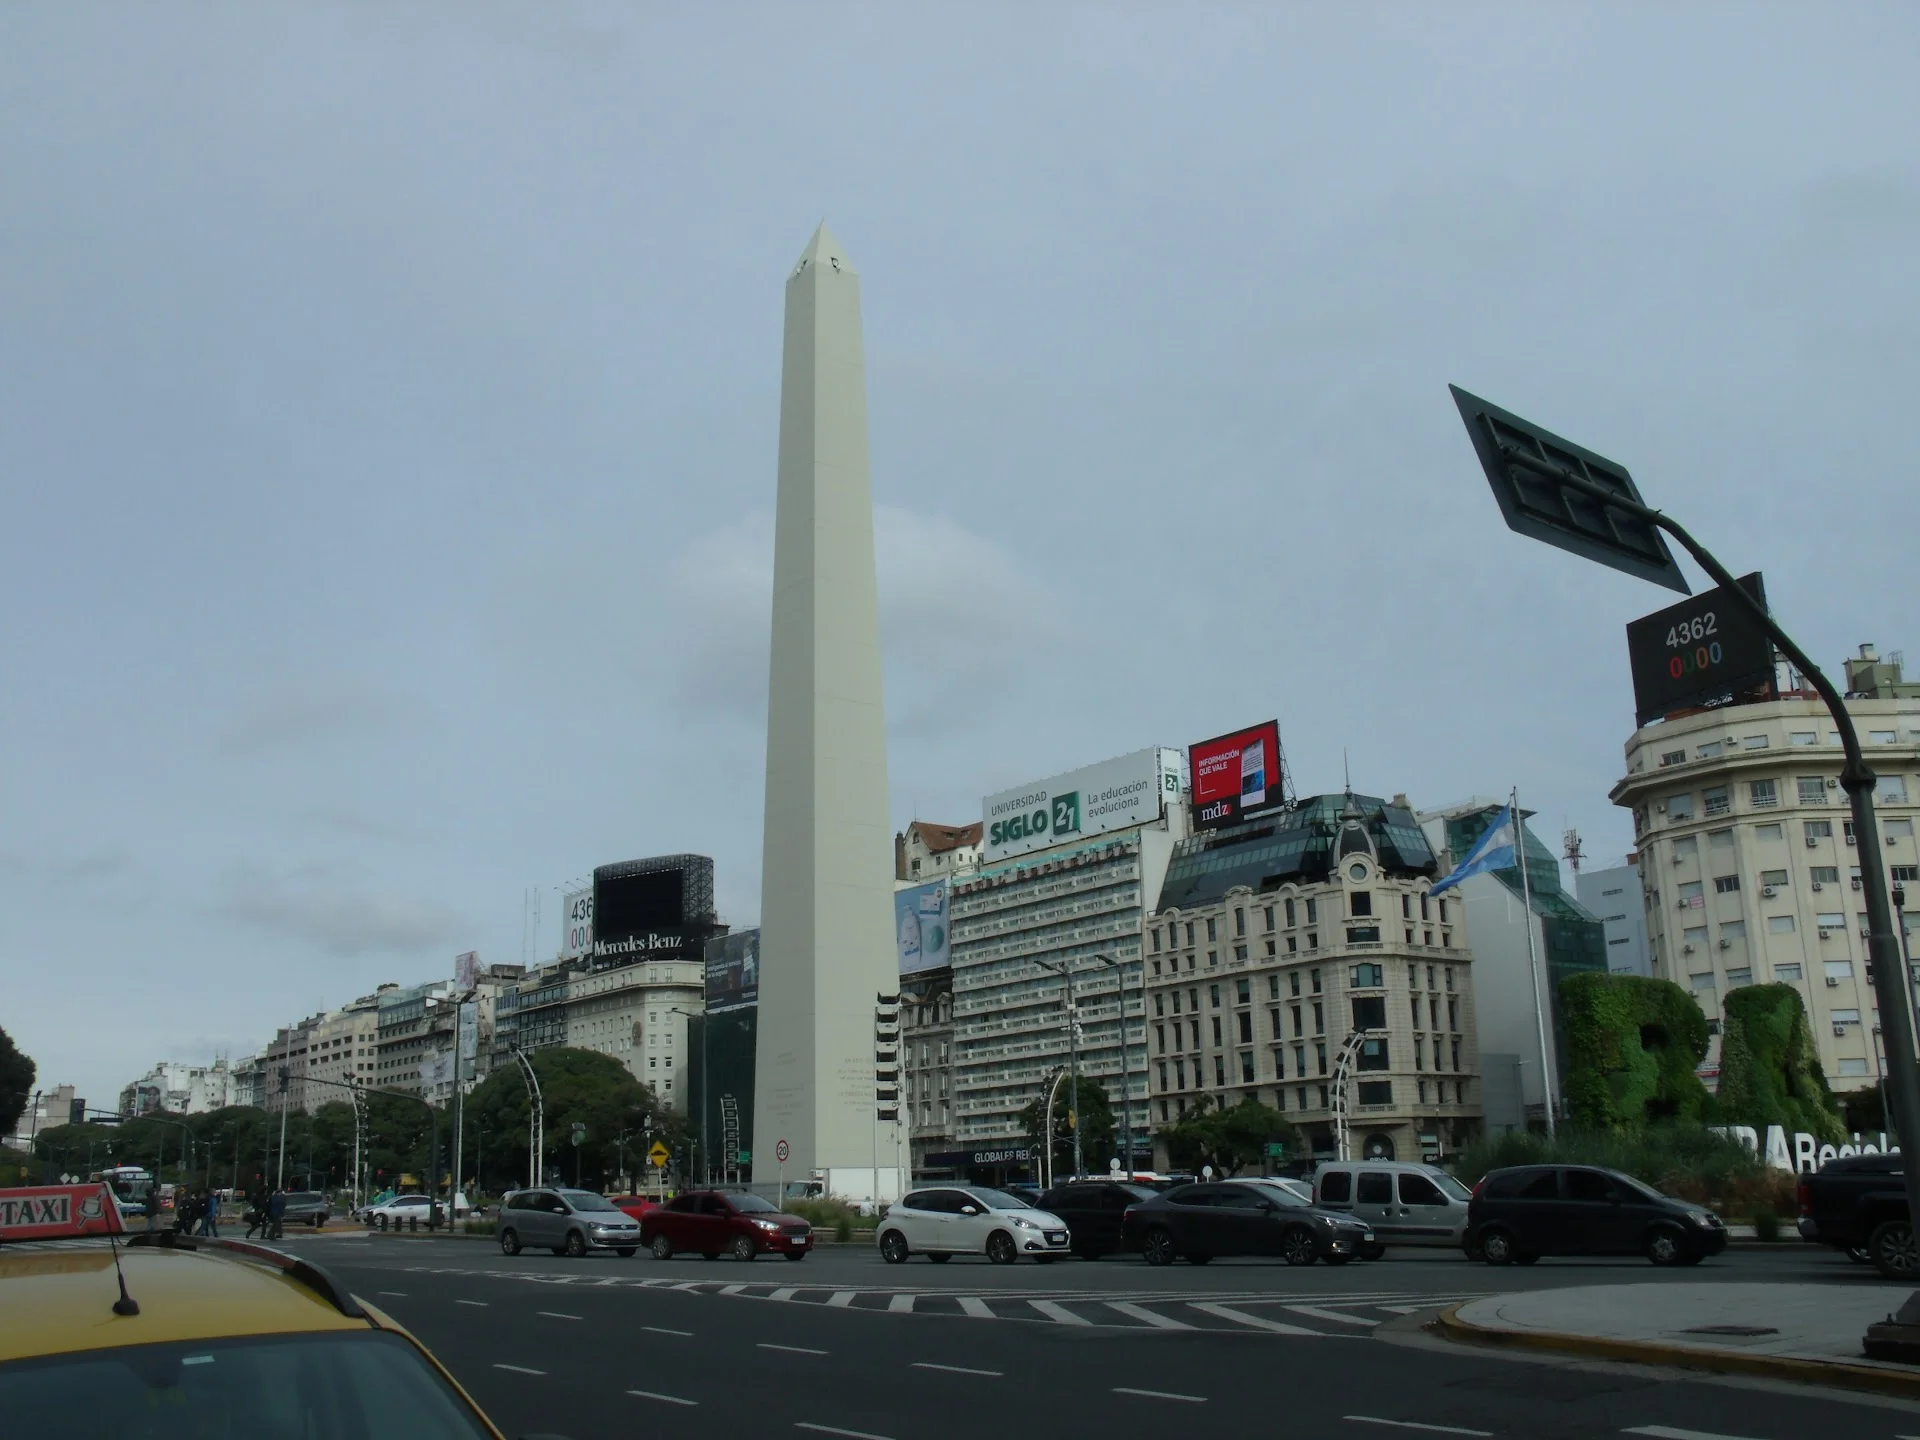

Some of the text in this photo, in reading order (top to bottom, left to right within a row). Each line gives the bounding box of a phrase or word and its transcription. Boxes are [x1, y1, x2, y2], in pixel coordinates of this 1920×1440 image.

[1665, 611, 1718, 648] 4362
[1669, 641, 1722, 680] 0000
[1198, 748, 1240, 768] INFORMACIÓN
[1199, 762, 1228, 776] QUE VALE
[1088, 779, 1148, 805] La educación
[1166, 777, 1177, 791] 21
[991, 791, 1047, 816] UNIVERSIDAD
[1088, 797, 1139, 818] evoluciona
[1201, 801, 1229, 821] mdz
[989, 801, 1075, 846] SIGLO 21
[594, 933, 683, 957] Mercedes-Benz
[778, 1146, 787, 1156] 20
[974, 1150, 1015, 1163] GLOBALES
[0, 1198, 68, 1225] TAXI
